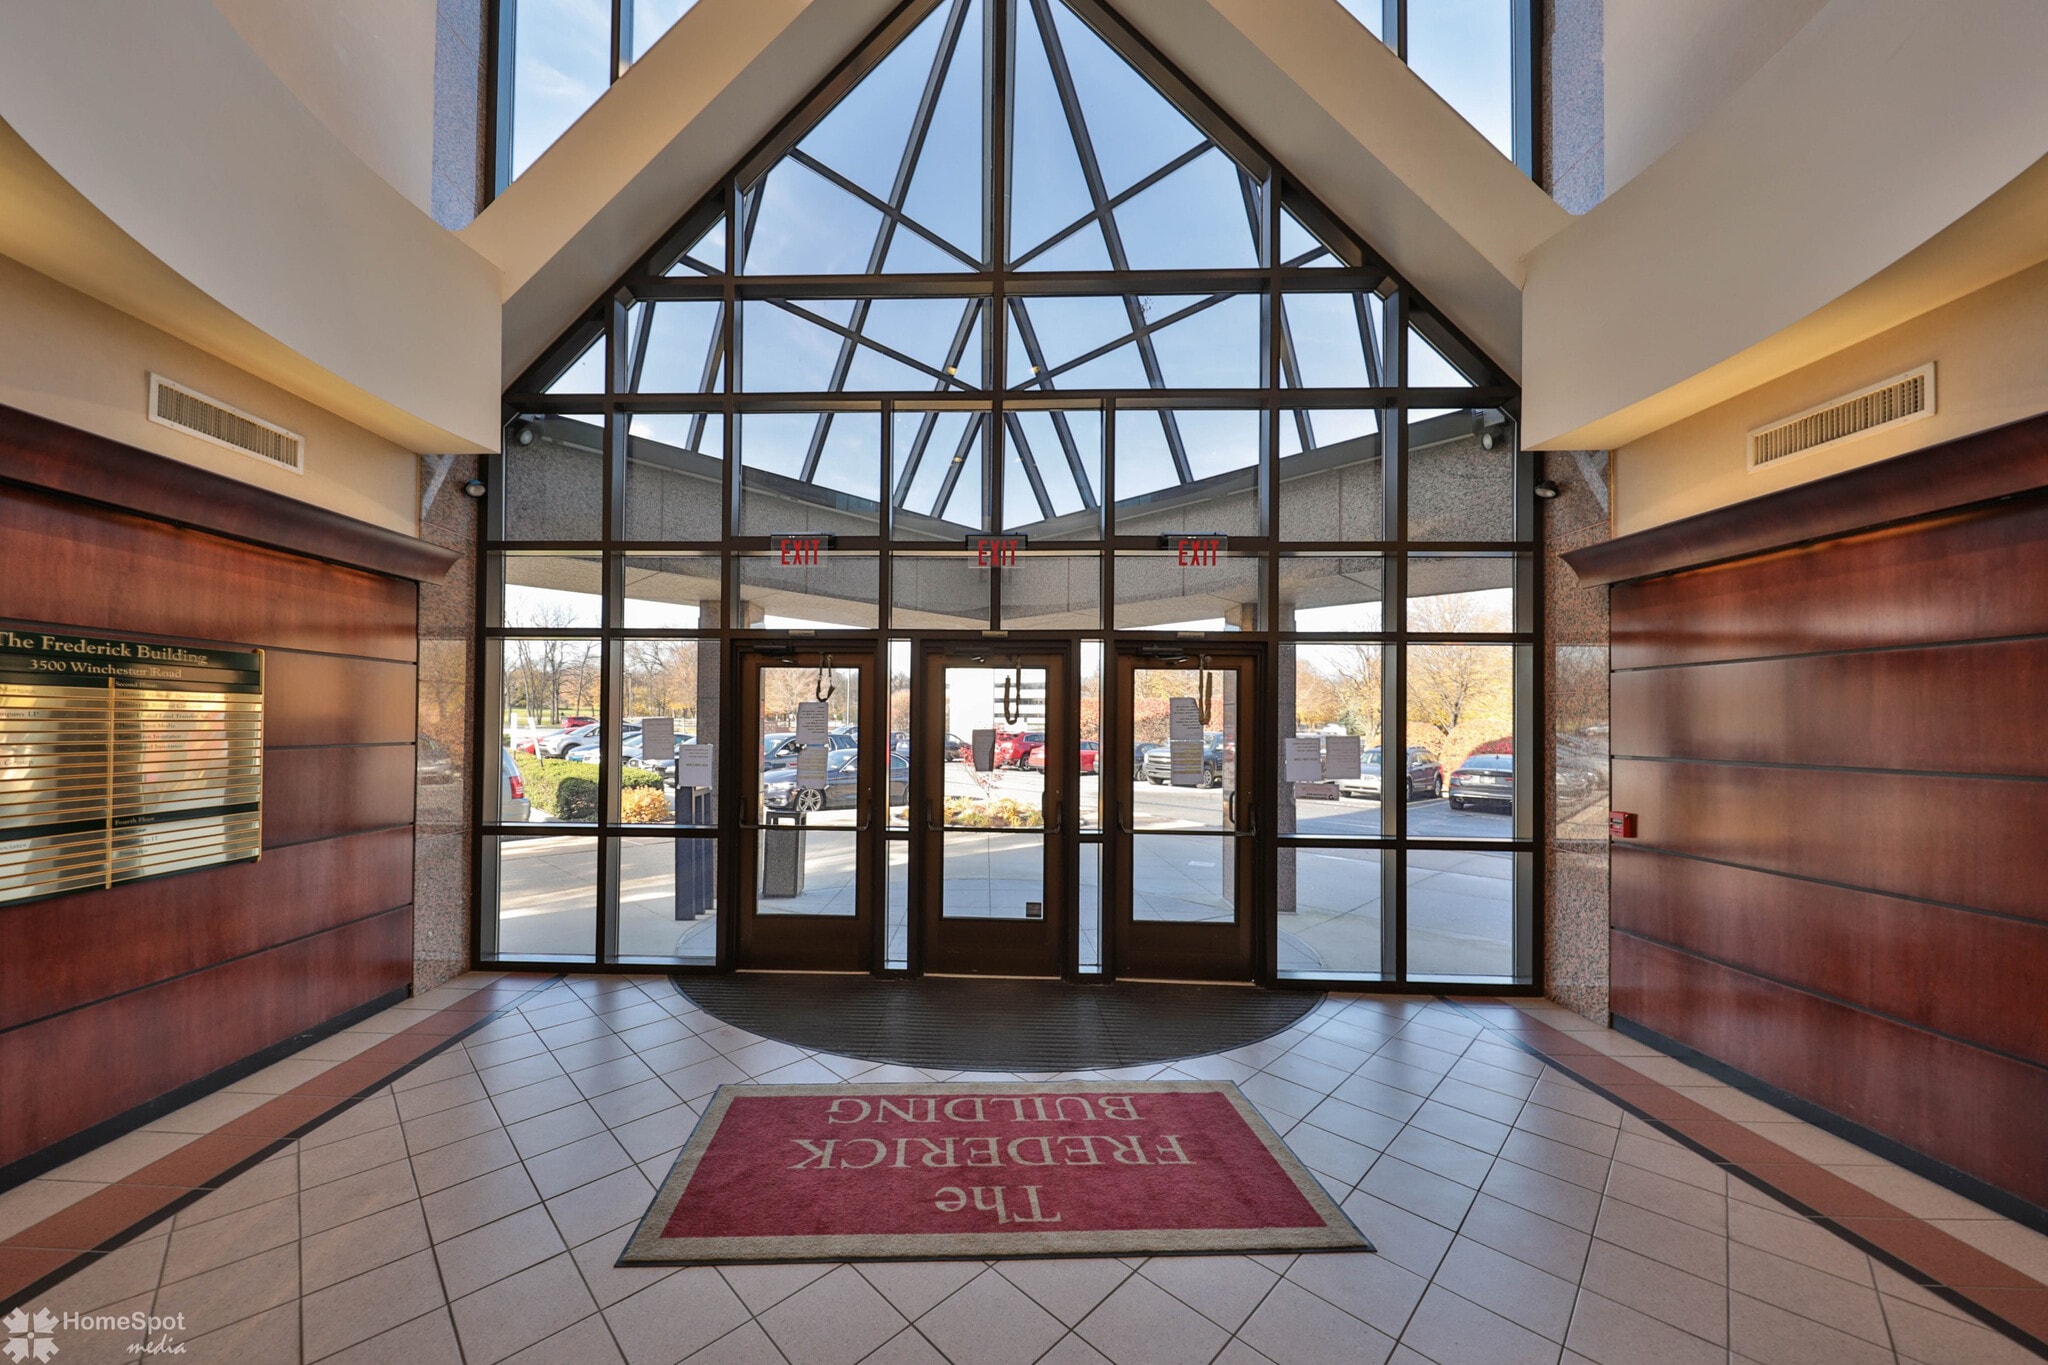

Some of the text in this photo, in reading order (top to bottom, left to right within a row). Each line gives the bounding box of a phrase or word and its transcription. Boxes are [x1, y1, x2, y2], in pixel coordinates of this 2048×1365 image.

[780, 538, 819, 566] EXIT
[977, 538, 1017, 567] EXIT
[1178, 539, 1217, 567] EXIT
[0, 631, 208, 665] The Frederick Building
[29, 659, 182, 678] 3500 Winchester Road
[4, 758, 34, 768] Group
[827, 1096, 1143, 1123] BUILDING
[787, 1135, 1196, 1170] FREDERICK
[934, 1184, 1062, 1224] The
